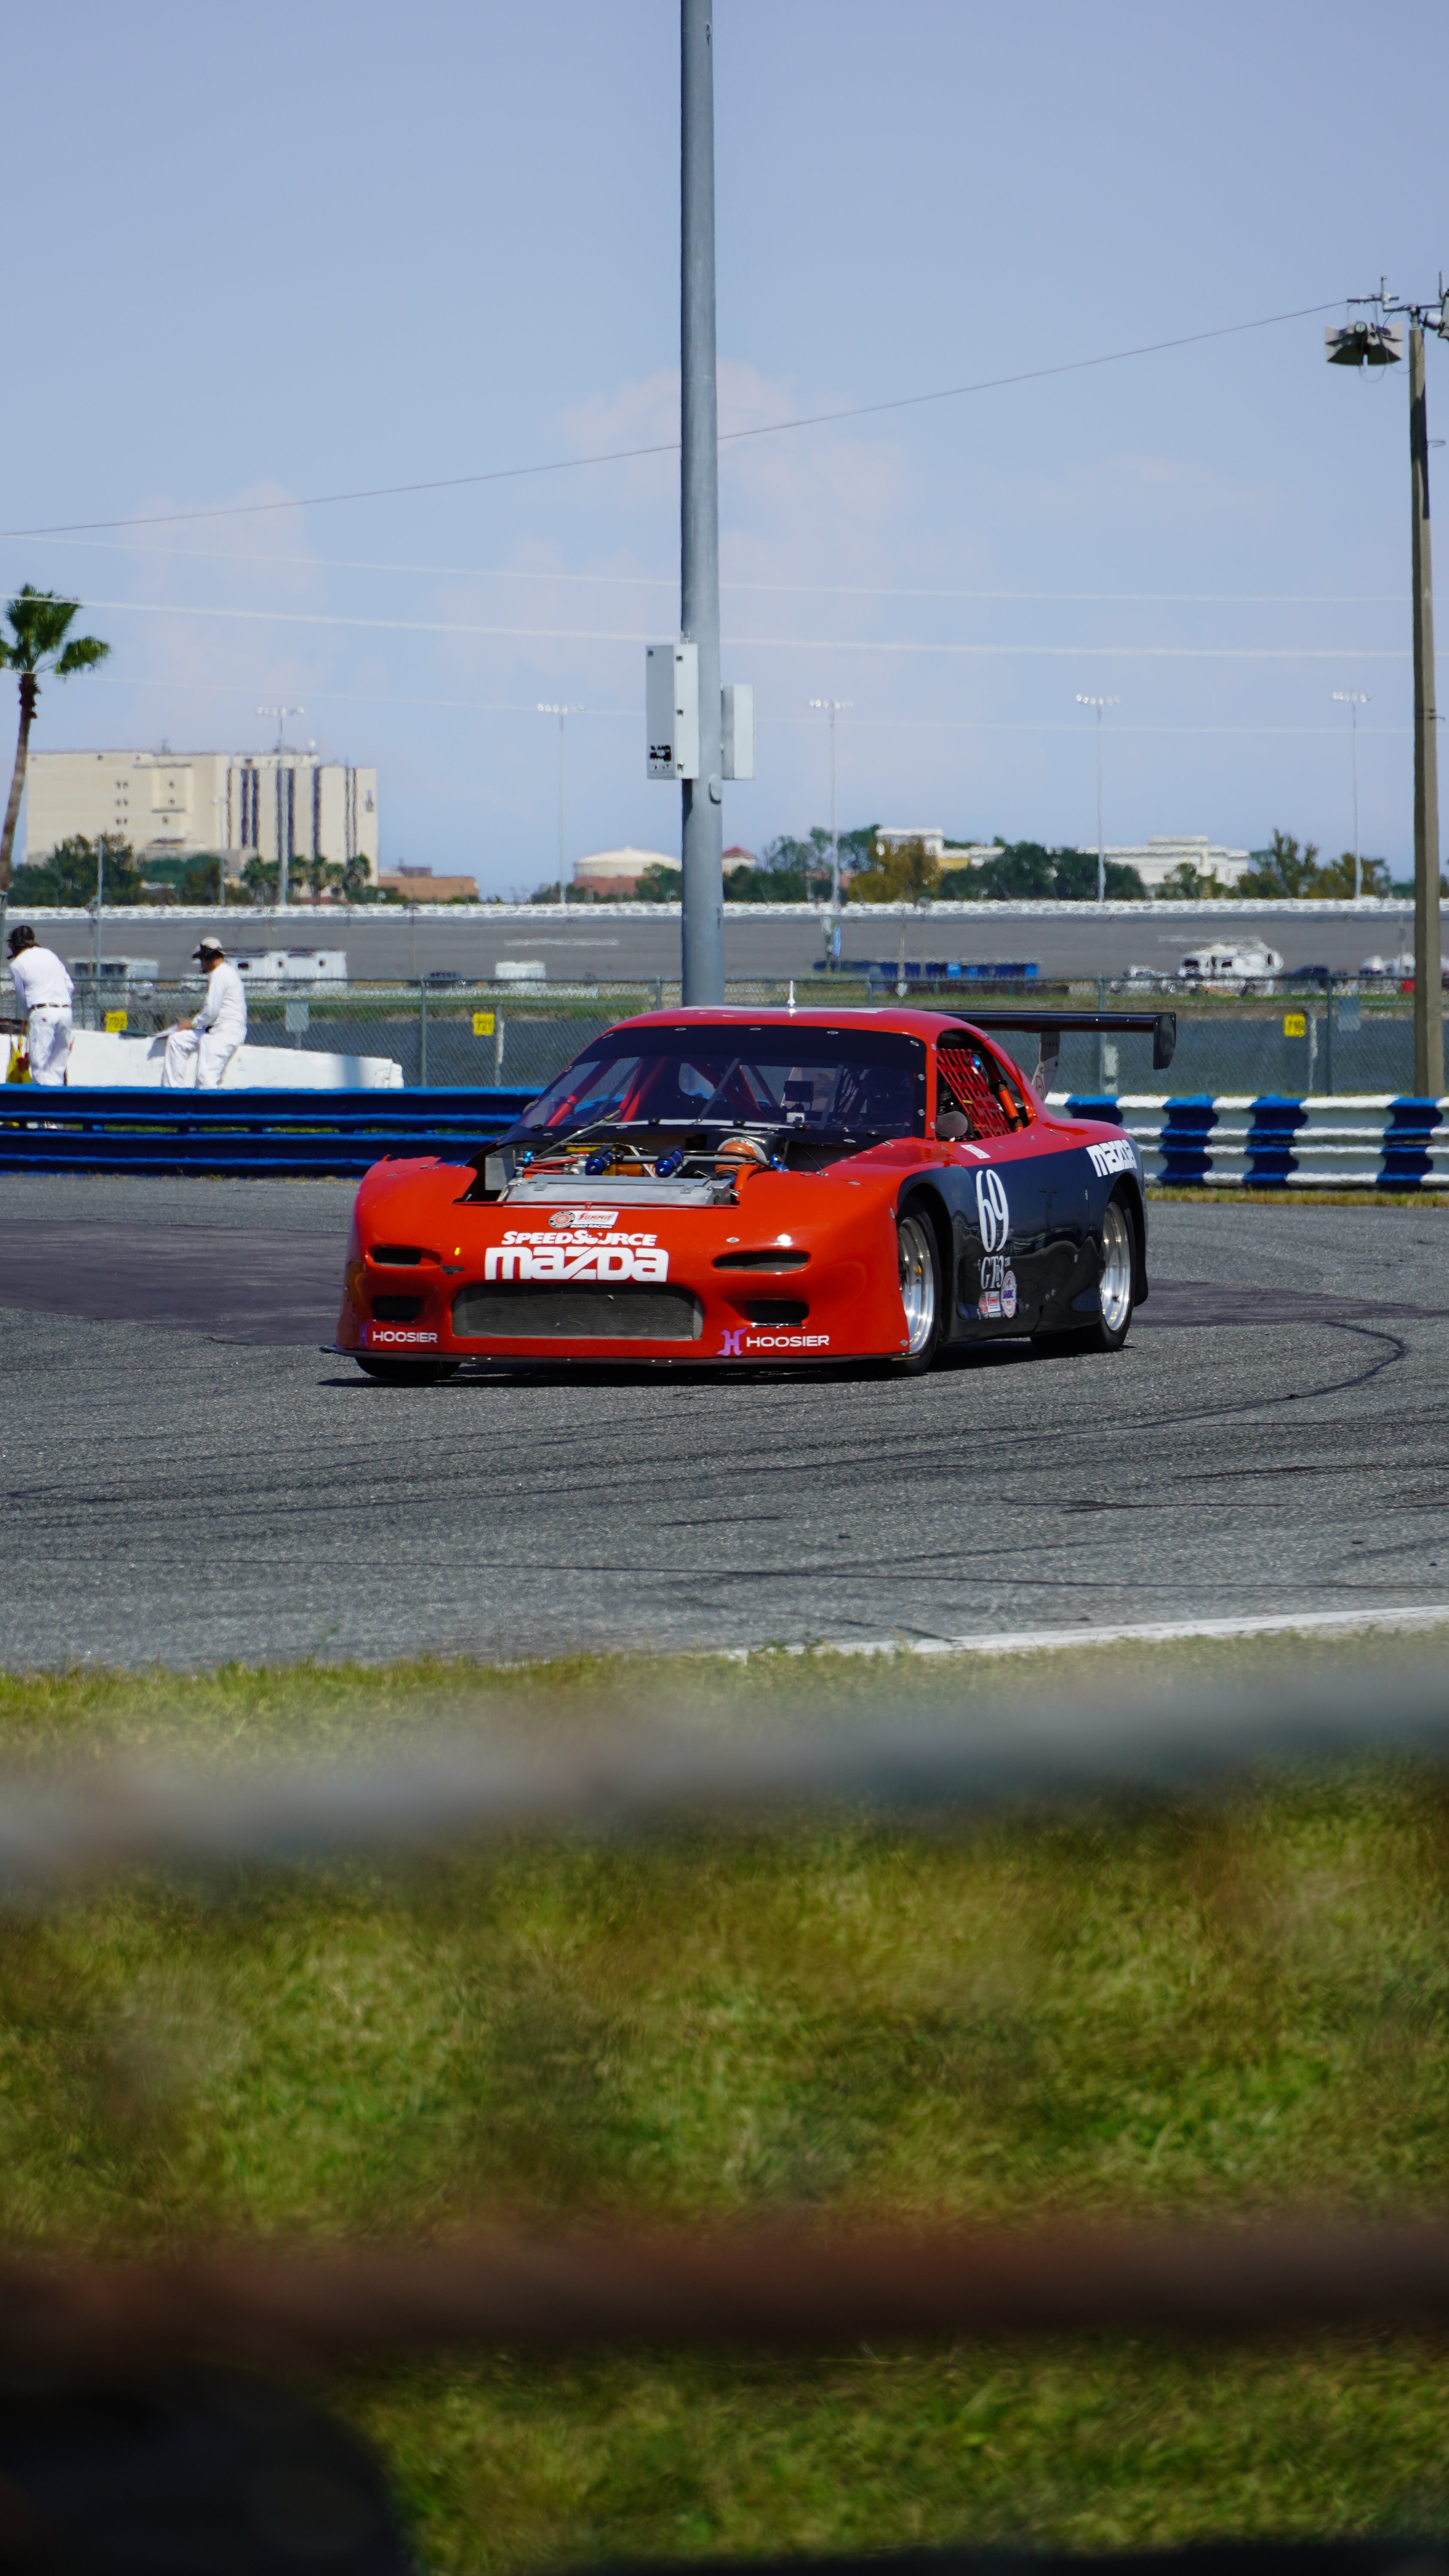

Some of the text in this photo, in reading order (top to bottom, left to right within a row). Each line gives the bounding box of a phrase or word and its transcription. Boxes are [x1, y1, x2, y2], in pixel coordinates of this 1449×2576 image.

[976, 1169, 1009, 1252] 69
[373, 1331, 438, 1343] HOOSIER
[746, 1335, 830, 1347] HOOSIER
